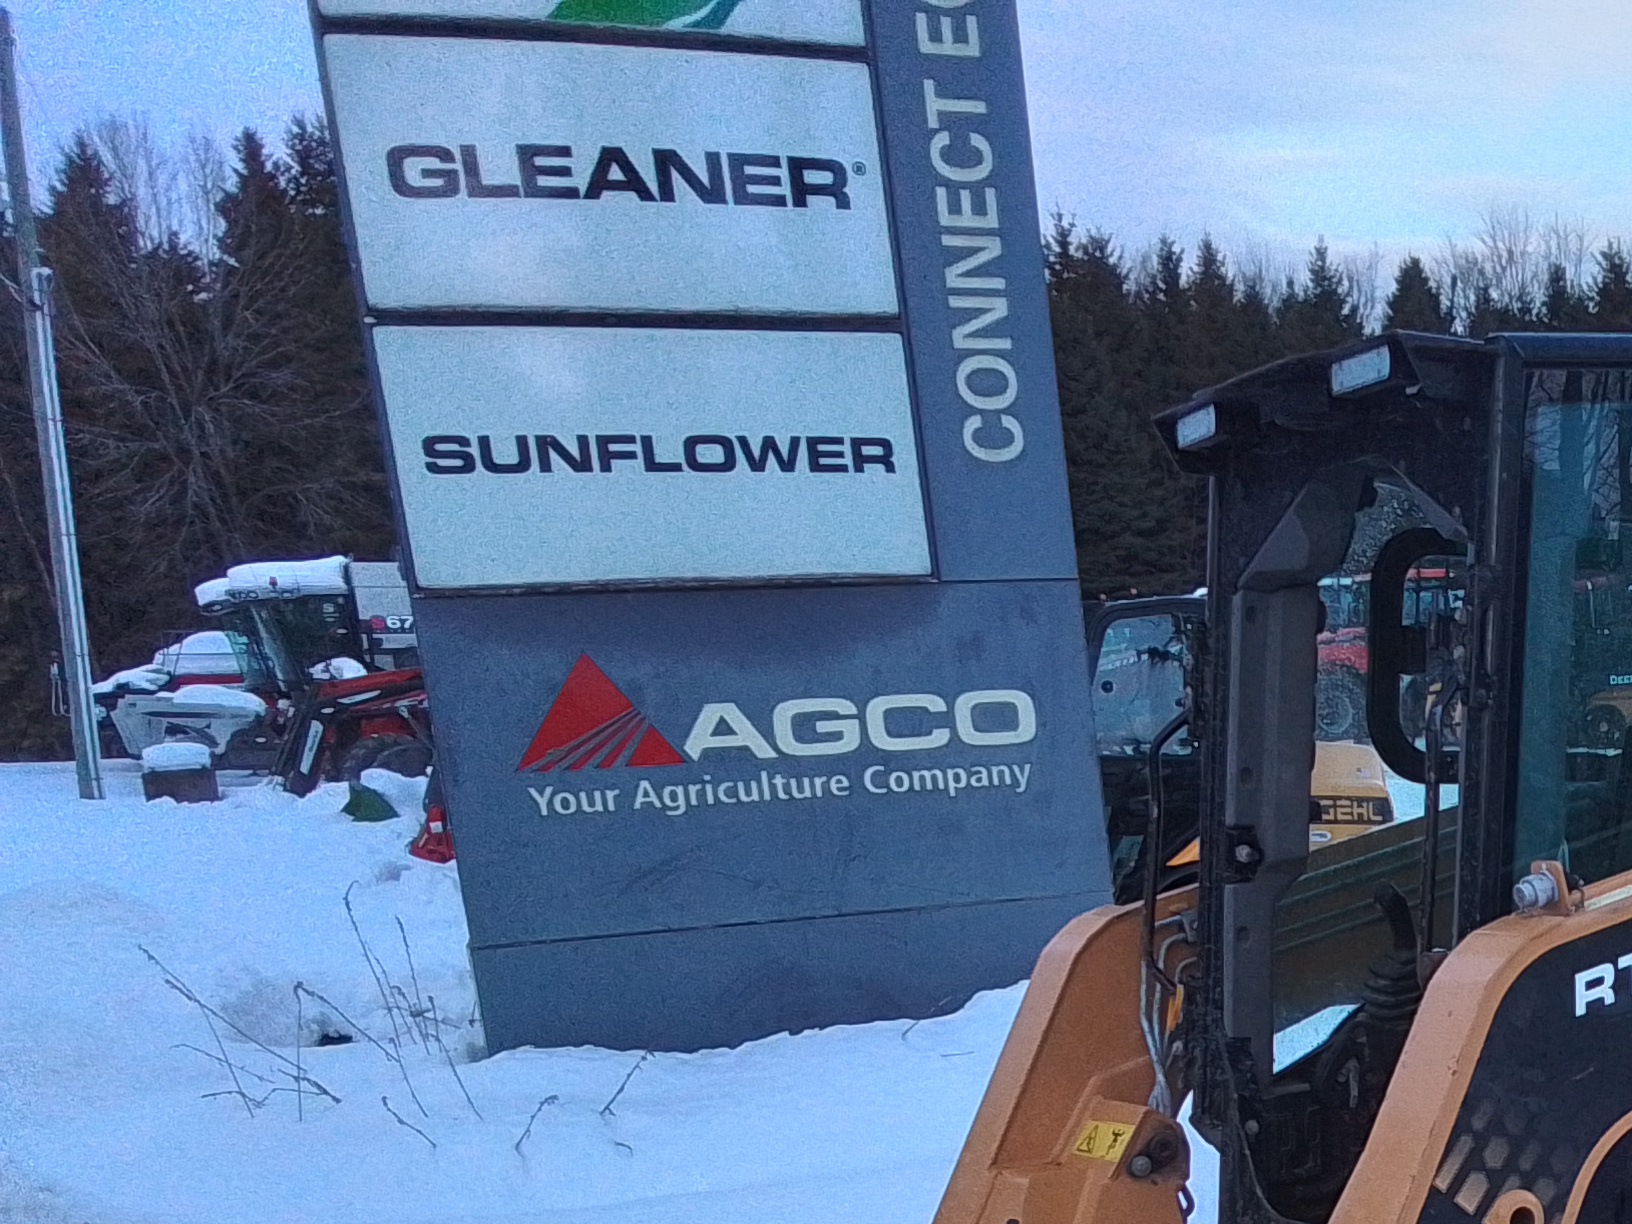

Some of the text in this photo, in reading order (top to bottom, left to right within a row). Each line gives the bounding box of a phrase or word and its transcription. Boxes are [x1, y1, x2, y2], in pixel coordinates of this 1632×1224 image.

[924, 79, 1024, 464] CONNECT
[422, 434, 896, 475] SUNFLOWER
[683, 689, 1037, 762] AGCO
[528, 761, 1032, 817] Your Agriculture Company
